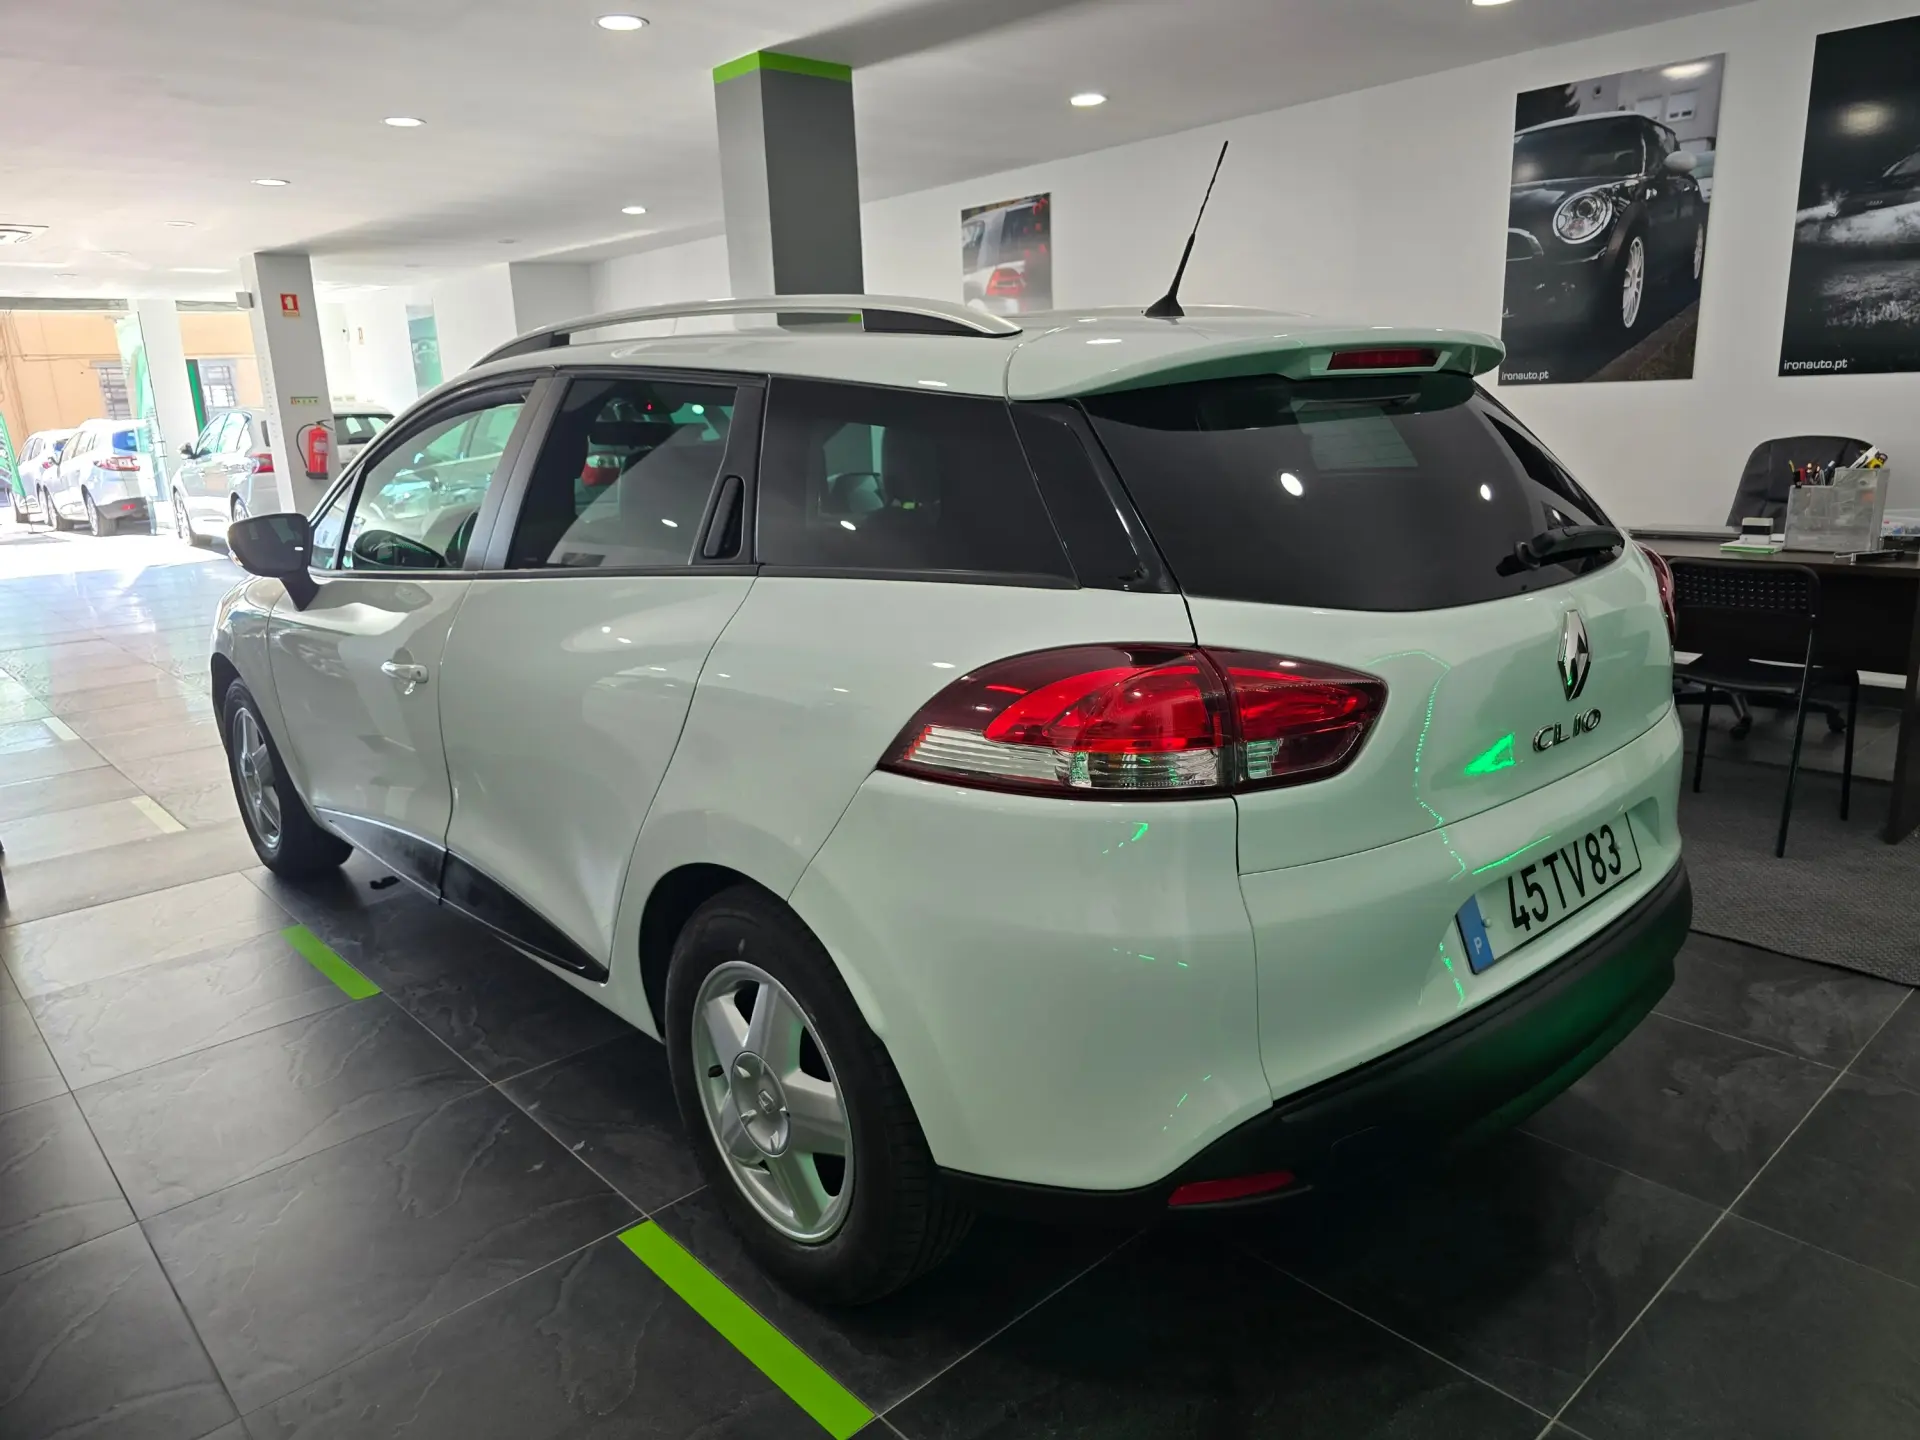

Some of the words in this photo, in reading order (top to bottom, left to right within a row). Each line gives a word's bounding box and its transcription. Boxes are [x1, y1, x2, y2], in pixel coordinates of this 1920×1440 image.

[1783, 358, 1848, 370] ironauto.pt
[1501, 370, 1549, 381] ironauto.pt
[1532, 707, 1602, 753] CLIO
[1473, 936, 1483, 954] P
